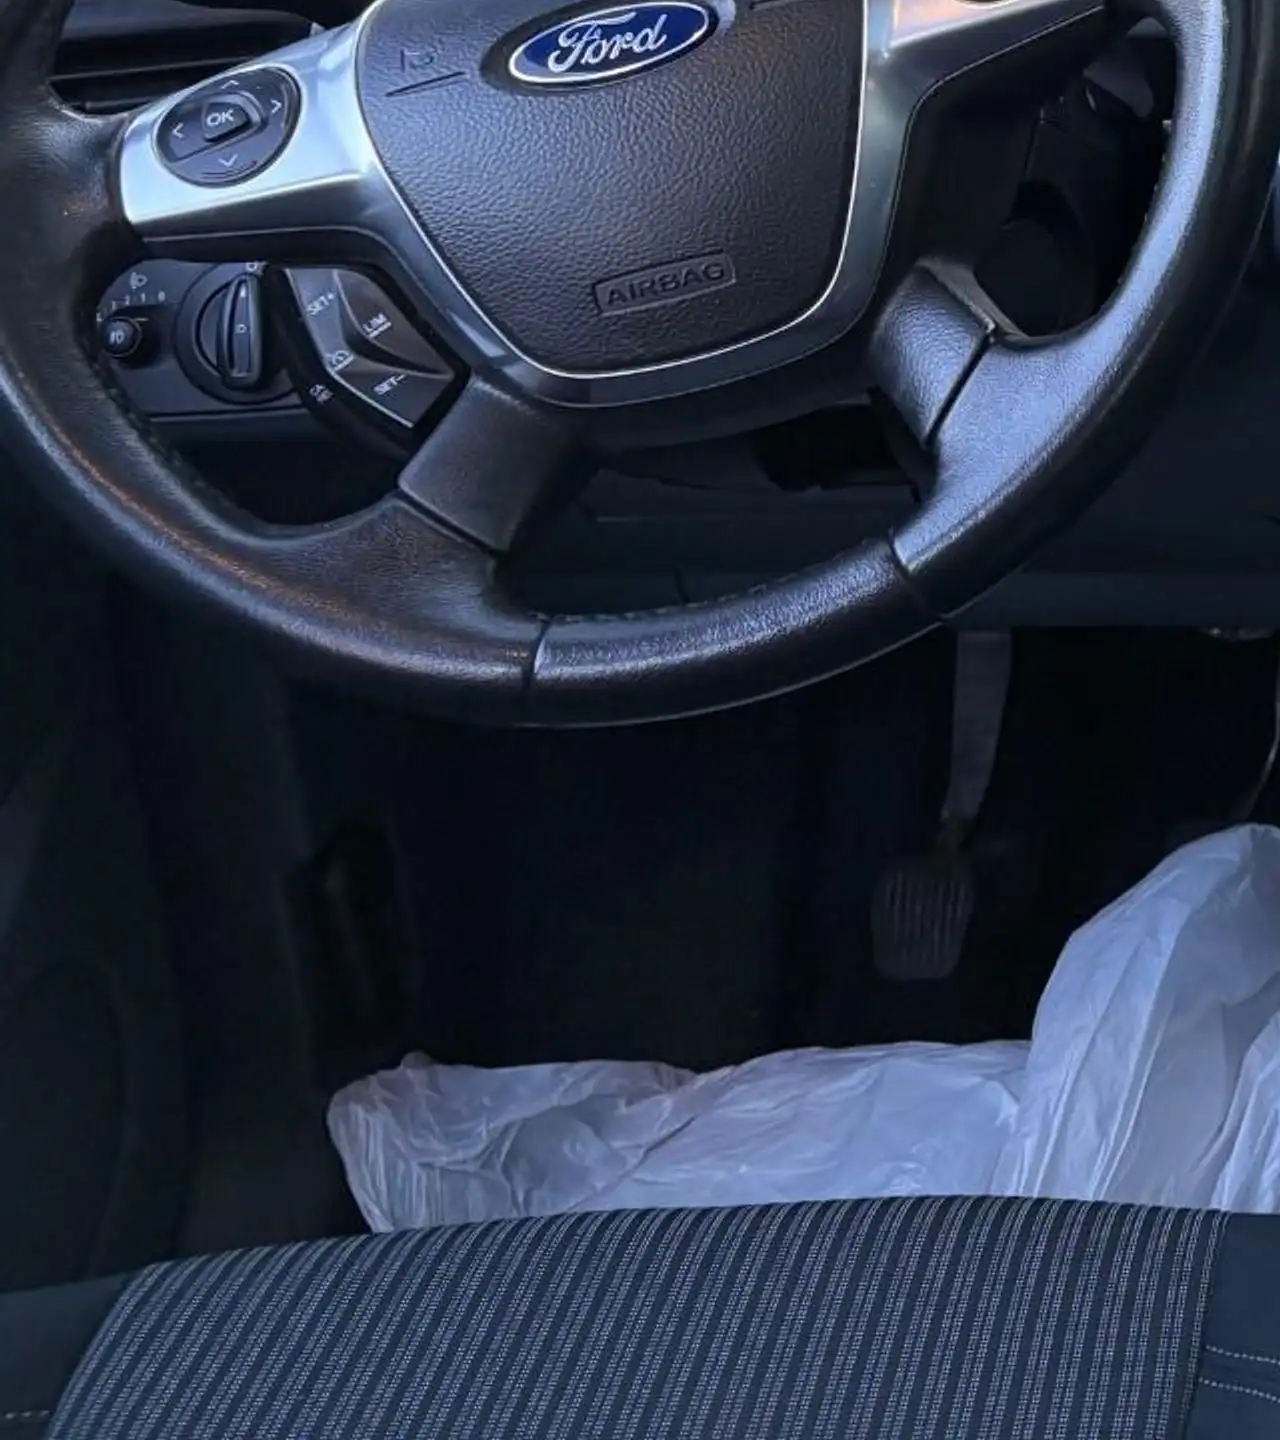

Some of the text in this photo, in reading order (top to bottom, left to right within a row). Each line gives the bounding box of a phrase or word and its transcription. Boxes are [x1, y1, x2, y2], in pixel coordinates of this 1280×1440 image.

[548, 12, 667, 72] Ford
[206, 109, 234, 126] OK
[608, 264, 724, 305] AIRBAG
[363, 312, 388, 333] LIM
